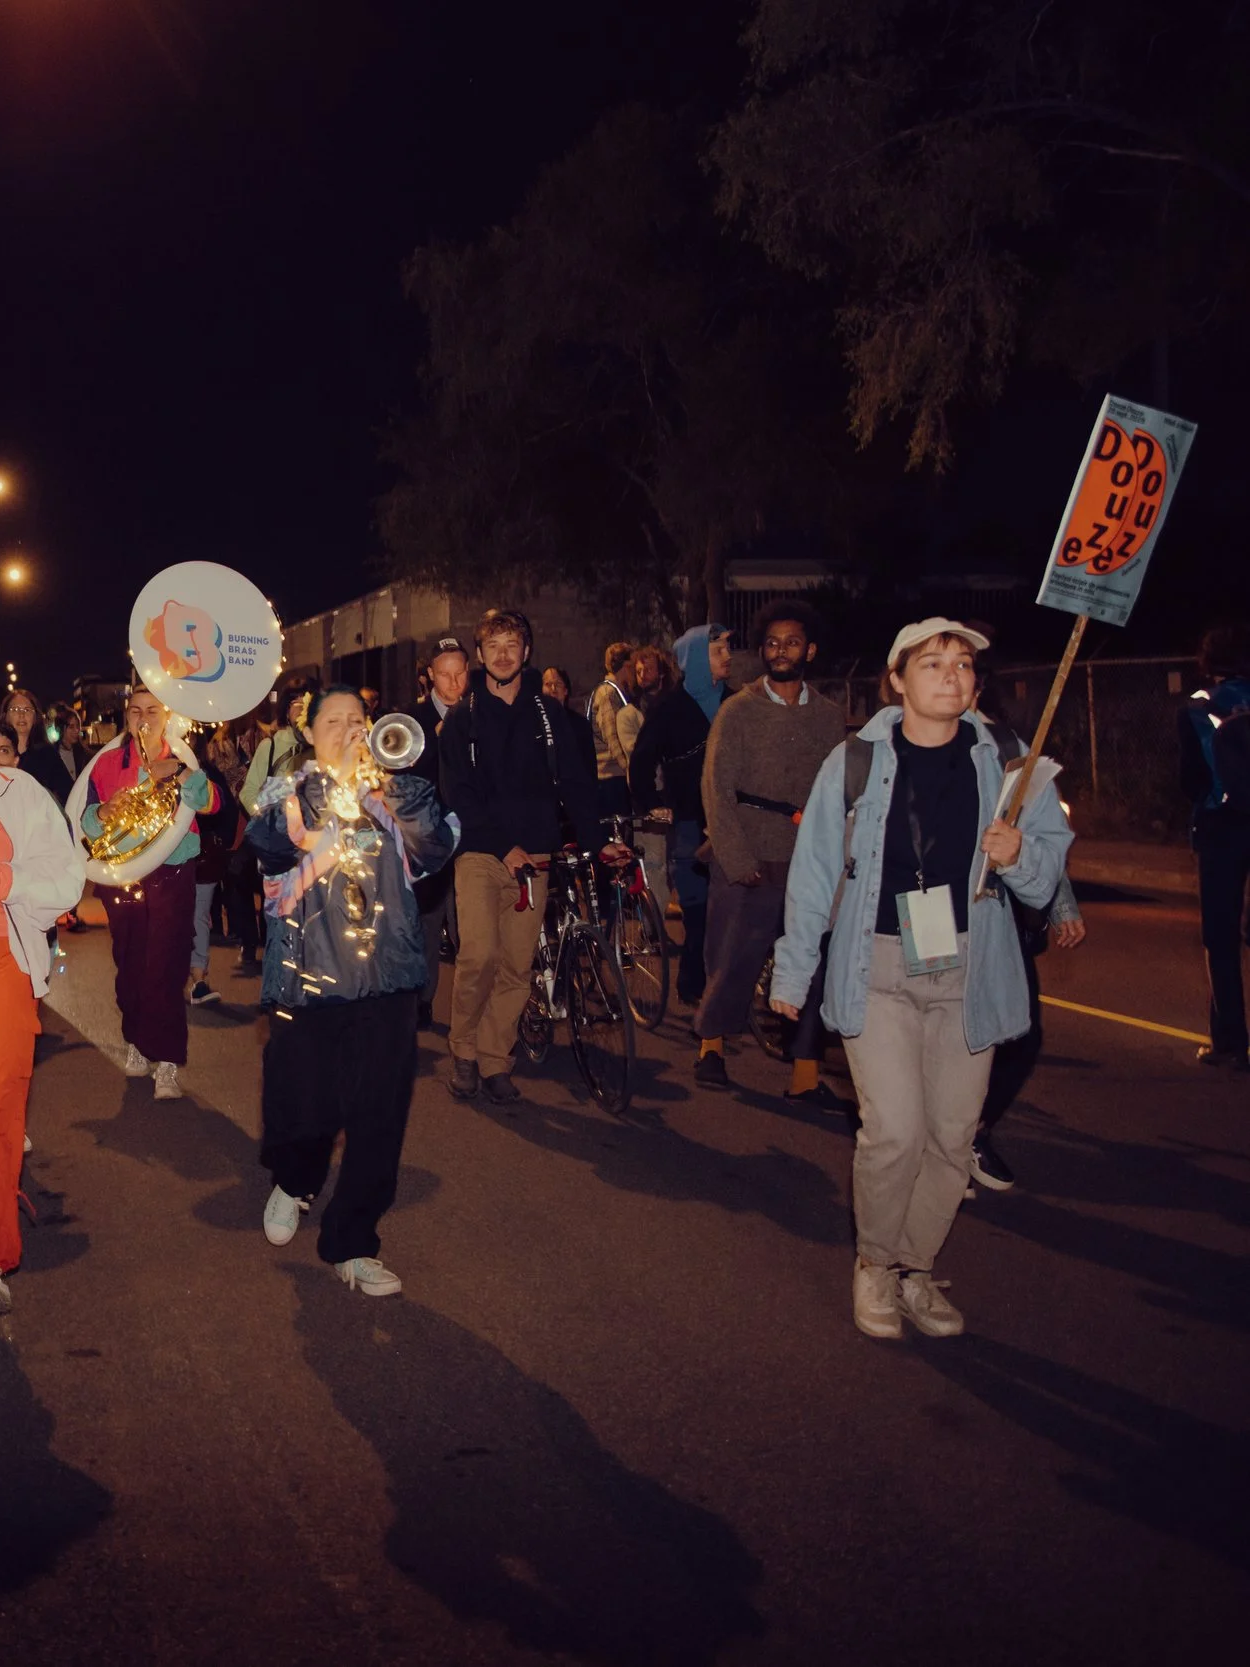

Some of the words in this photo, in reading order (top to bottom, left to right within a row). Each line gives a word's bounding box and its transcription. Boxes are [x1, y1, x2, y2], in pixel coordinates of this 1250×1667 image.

[1061, 424, 1134, 563] Douze
[228, 634, 269, 646] BURNING
[228, 655, 255, 666] BAND
